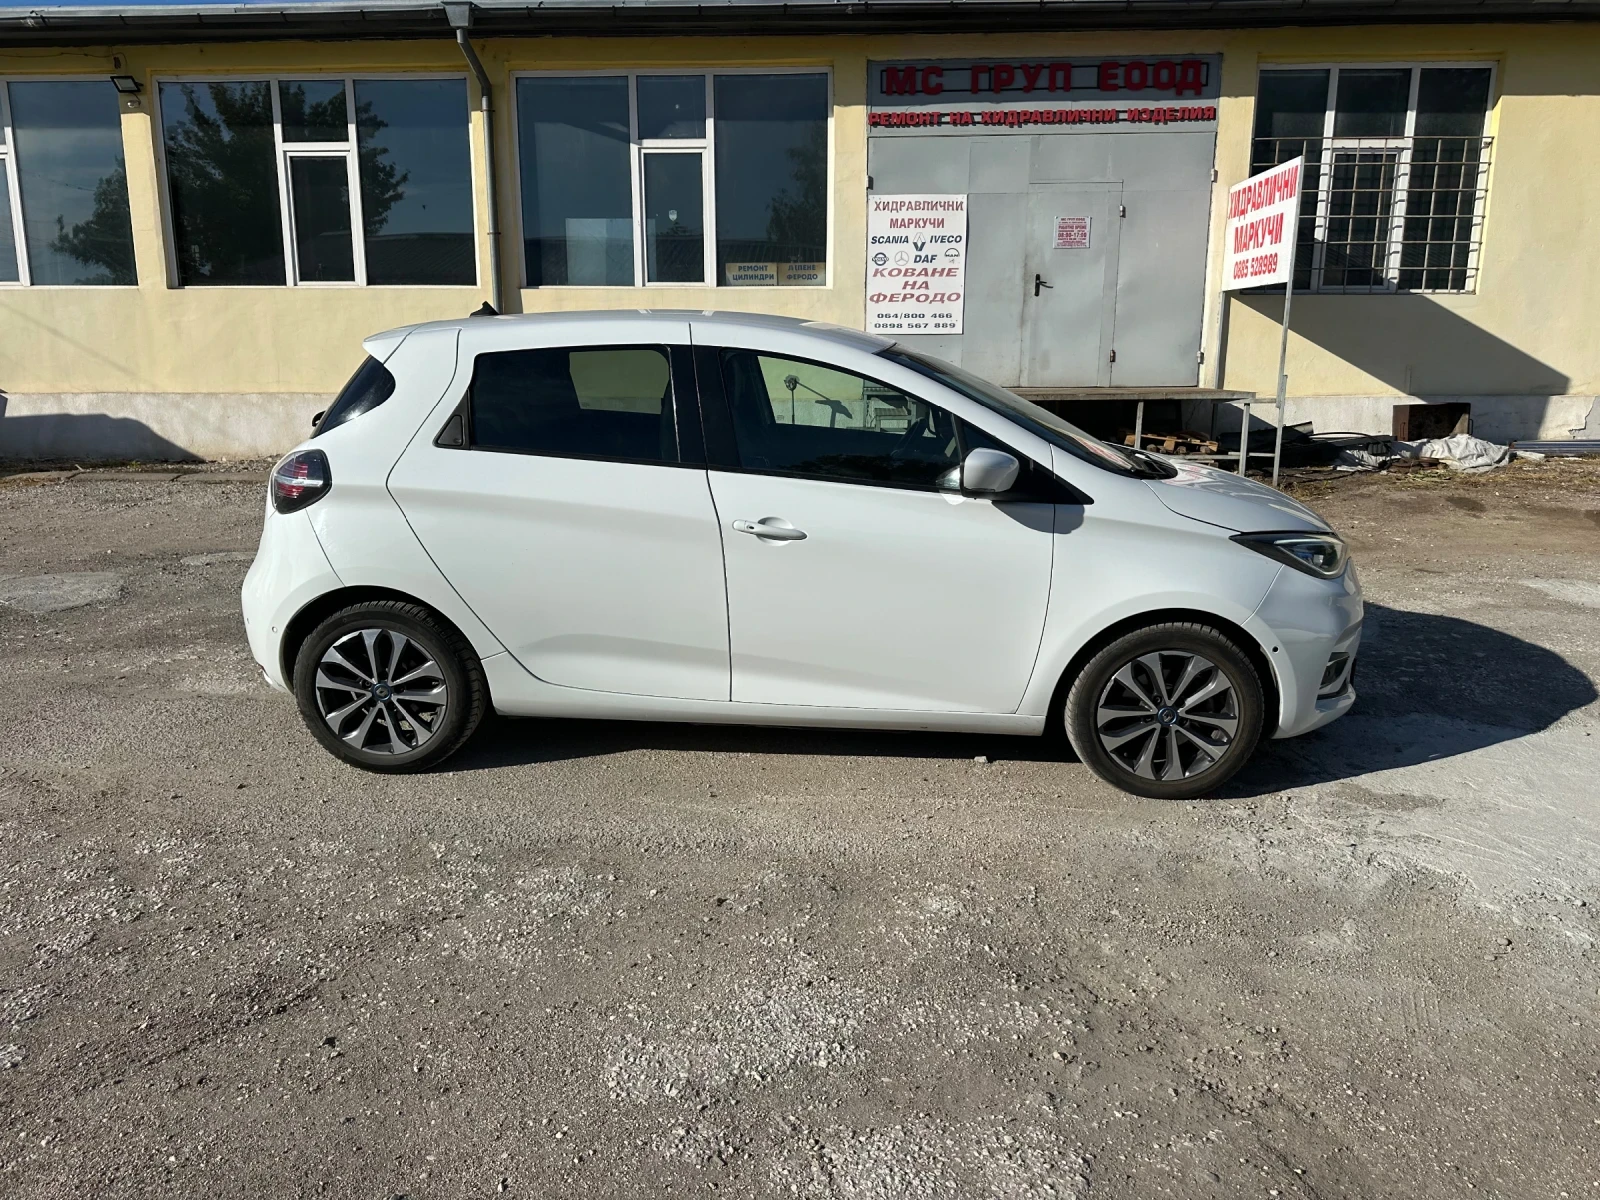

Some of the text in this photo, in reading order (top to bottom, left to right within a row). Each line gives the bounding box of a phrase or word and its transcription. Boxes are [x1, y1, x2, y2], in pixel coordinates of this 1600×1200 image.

[885, 60, 1202, 96] МС ГРУП ЕООД
[868, 106, 1215, 127] РЕМОНТ НА ХИДРАВЛИЧНИ ИЗДЕЛИЯ
[1228, 165, 1299, 222] ХИДРАВЛИЧНИ
[874, 200, 964, 213] ХИДРАВЛИЧНИ
[889, 218, 945, 229] МАРКУЧИ
[1233, 212, 1284, 254] МАРКУЧИ
[871, 235, 962, 244] SCANIA IVECO
[913, 254, 937, 263] DAF
[1250, 252, 1278, 277] 528989
[732, 273, 774, 281] ЦИЛИНДРИ
[872, 267, 959, 278] КОВАНЕ
[902, 280, 930, 290] НА
[869, 292, 961, 304] ФЕРОДО
[877, 312, 925, 320] 064/800
